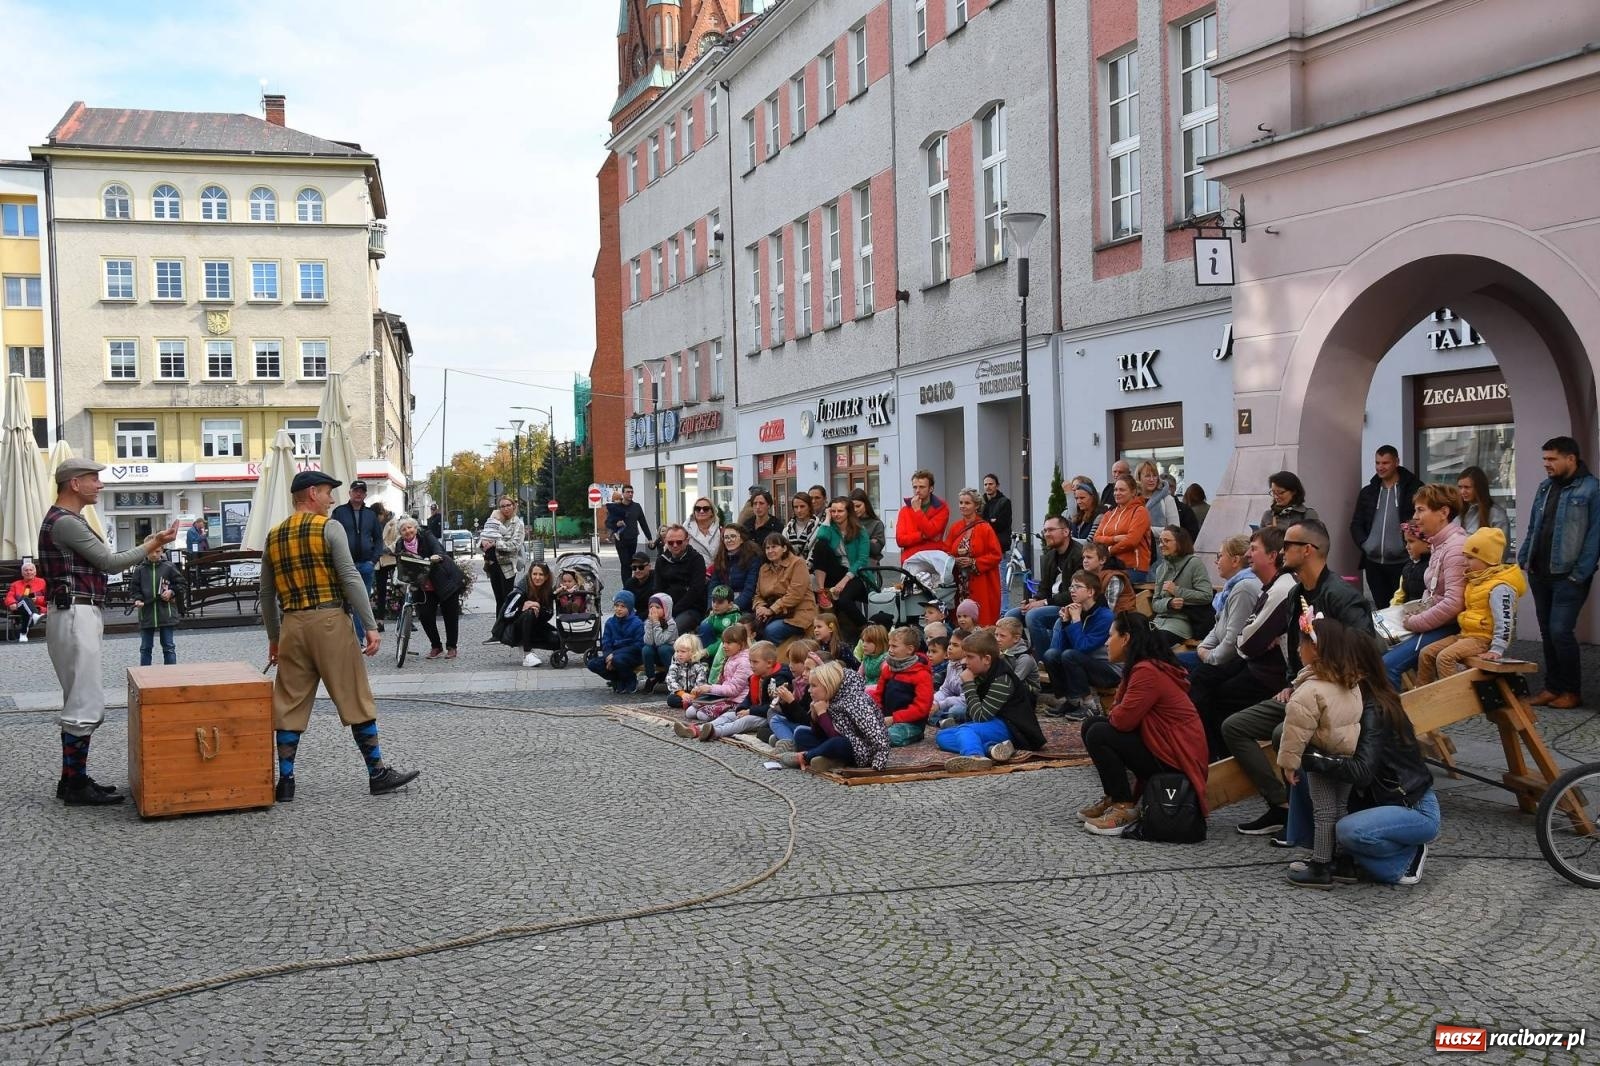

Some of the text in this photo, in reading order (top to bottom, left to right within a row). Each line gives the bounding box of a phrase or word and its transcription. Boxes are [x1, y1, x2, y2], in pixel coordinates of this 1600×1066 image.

[920, 381, 955, 405] BOLKO
[815, 398, 862, 423] JUBILER
[1131, 417, 1174, 432] ZŁOTNIK
[1502, 594, 1511, 620] TEAM
[1165, 788, 1177, 800] V
